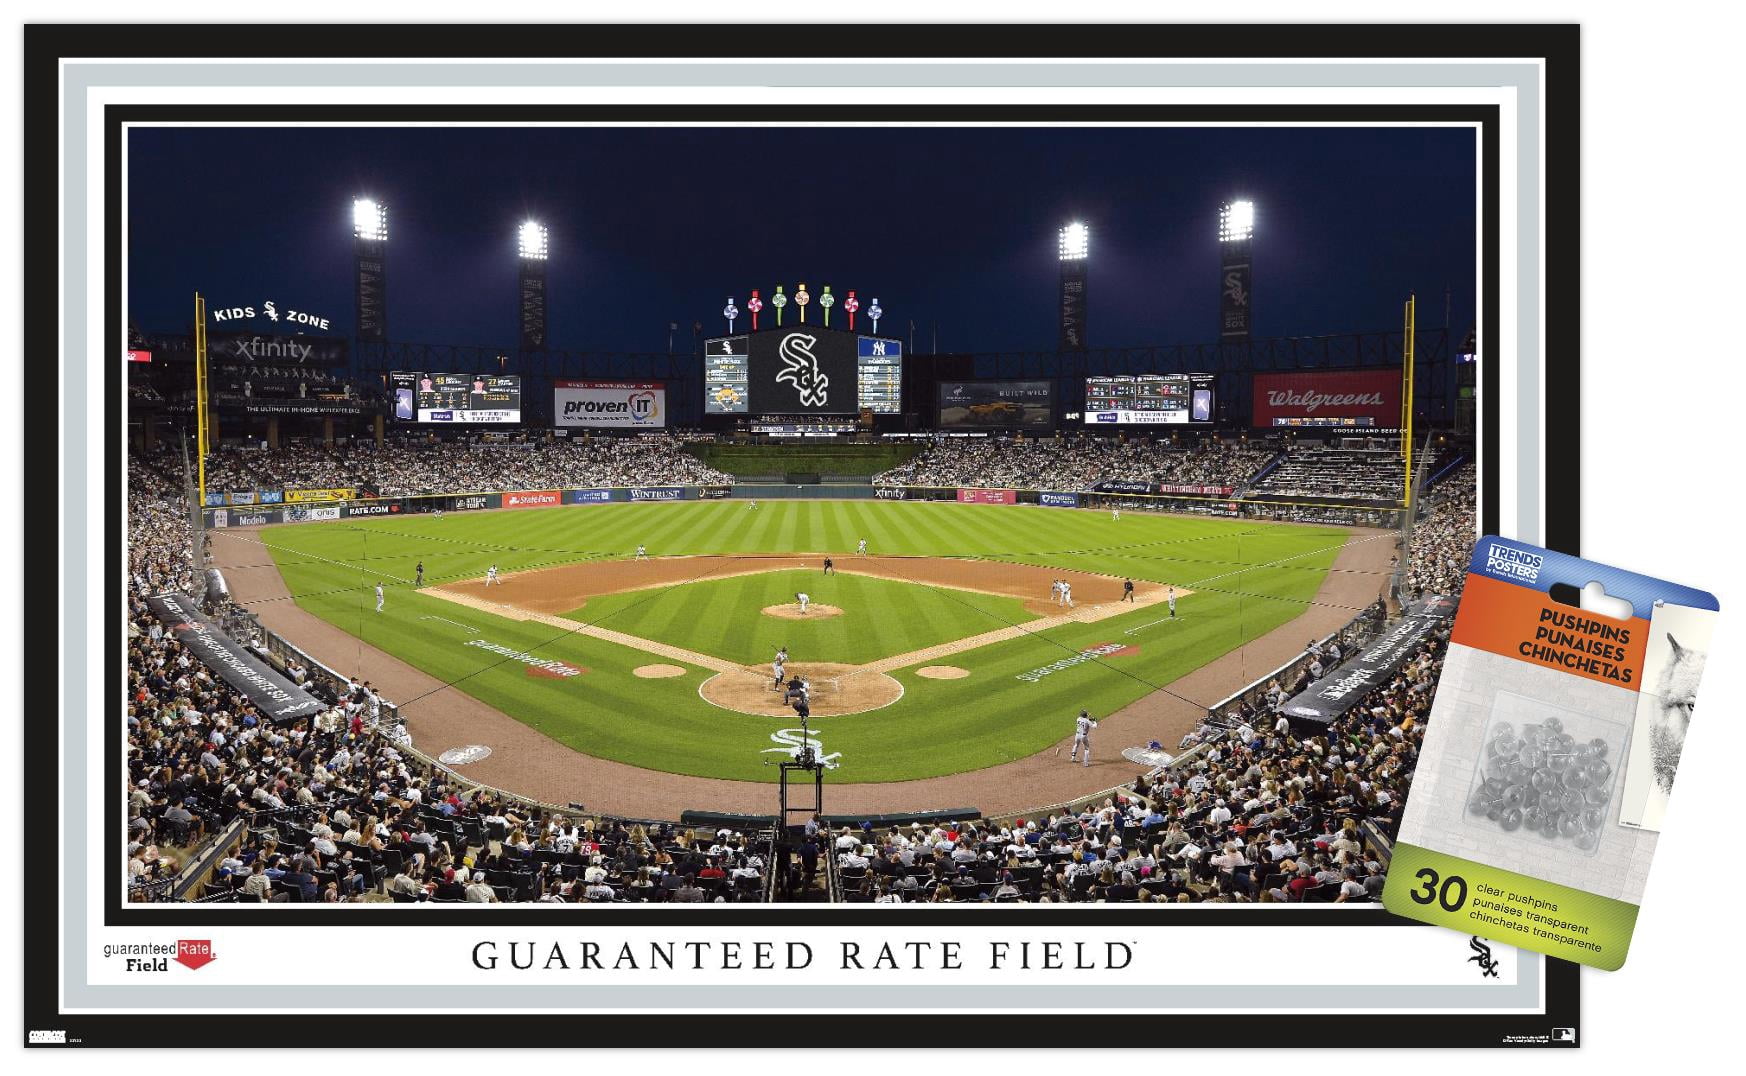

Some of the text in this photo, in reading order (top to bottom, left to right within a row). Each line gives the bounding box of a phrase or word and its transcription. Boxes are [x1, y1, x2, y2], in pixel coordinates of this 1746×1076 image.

[214, 305, 257, 322] KIDS
[286, 309, 331, 331] ZONE
[236, 336, 312, 363] xfinity
[999, 389, 1049, 398] BUILT WILD
[1268, 390, 1385, 412] Walgreens
[564, 399, 650, 415] proven IT
[631, 488, 681, 499] WINTRUST
[875, 487, 906, 500] xfinity
[239, 515, 267, 526] Modelo
[349, 505, 389, 515] RATE.COM
[1491, 545, 1542, 568] TRENDS
[1487, 557, 1539, 580] POSTERS
[1540, 608, 1631, 644] PUSHPINS
[1536, 626, 1626, 662] PUNAISES
[1518, 643, 1633, 682] CHINCHETAS
[1410, 868, 1468, 912] 30
[1477, 883, 1559, 912] clear pushpins
[1473, 897, 1590, 934] punaises transparent
[1470, 911, 1603, 953] chinchetas transparente
[103, 941, 209, 958] guaranteed Rate
[471, 941, 1132, 970] GUARANTEED RATE FIELD
[126, 958, 169, 972] Field
